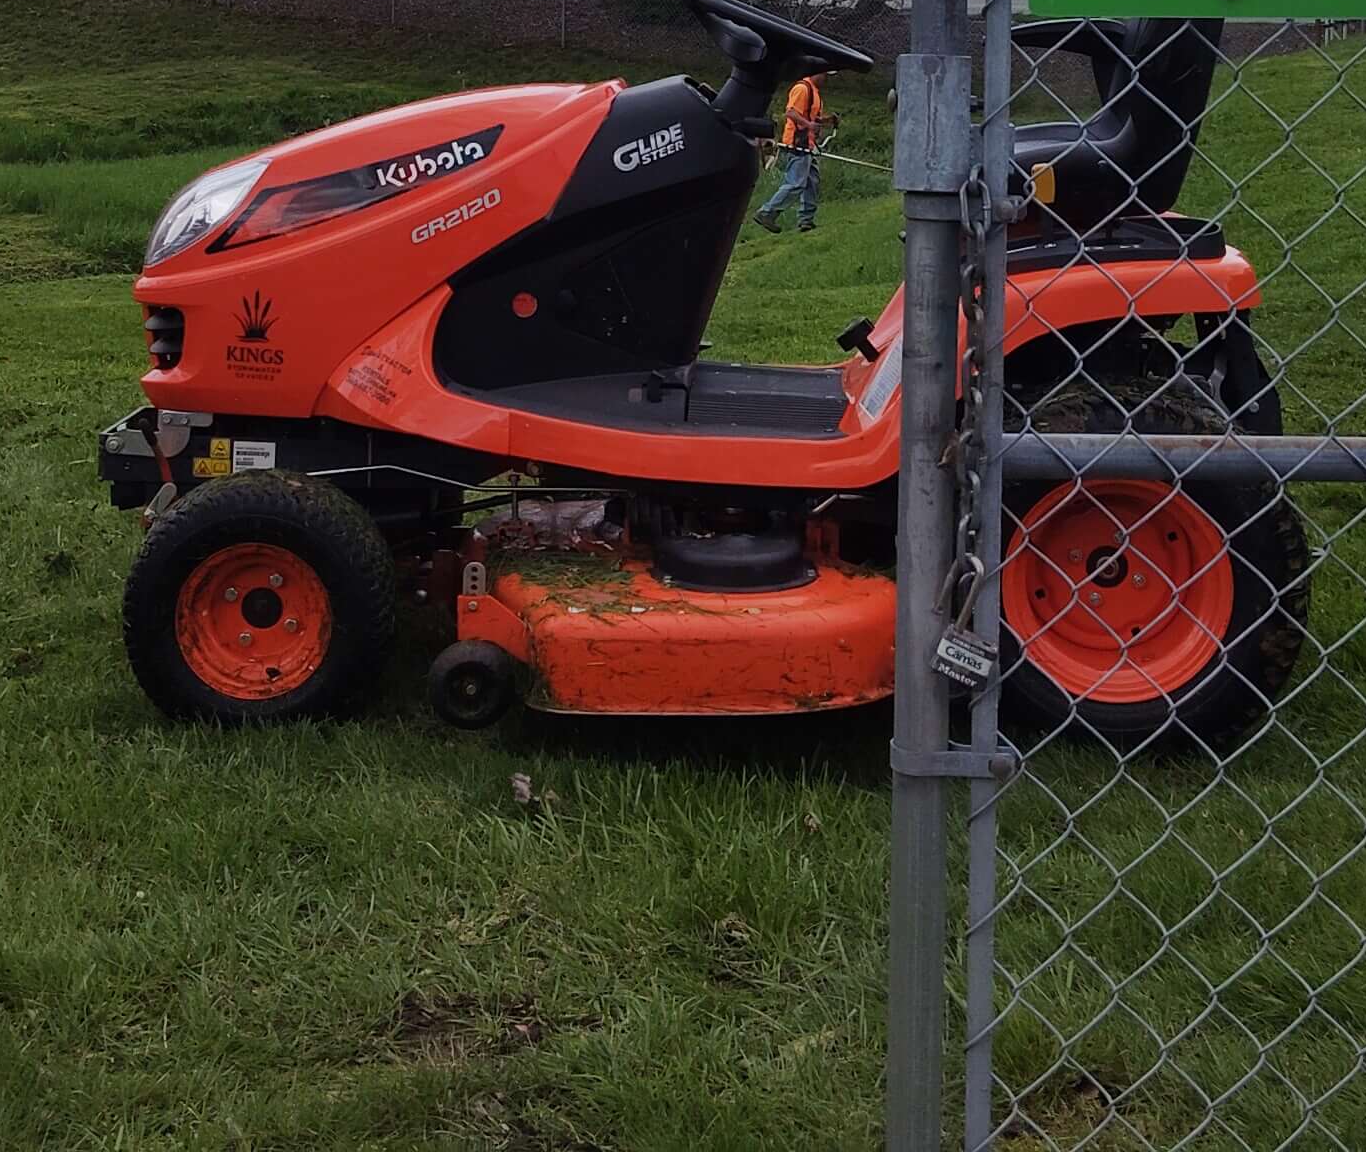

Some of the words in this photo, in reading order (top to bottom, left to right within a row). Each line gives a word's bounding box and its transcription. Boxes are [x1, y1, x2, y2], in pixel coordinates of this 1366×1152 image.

[376, 140, 485, 188] Kubota
[613, 122, 683, 172] GLIDE
[641, 140, 686, 165] STEER
[410, 188, 502, 244] GR2120
[226, 345, 284, 365] KINGS
[937, 662, 978, 687] Master
